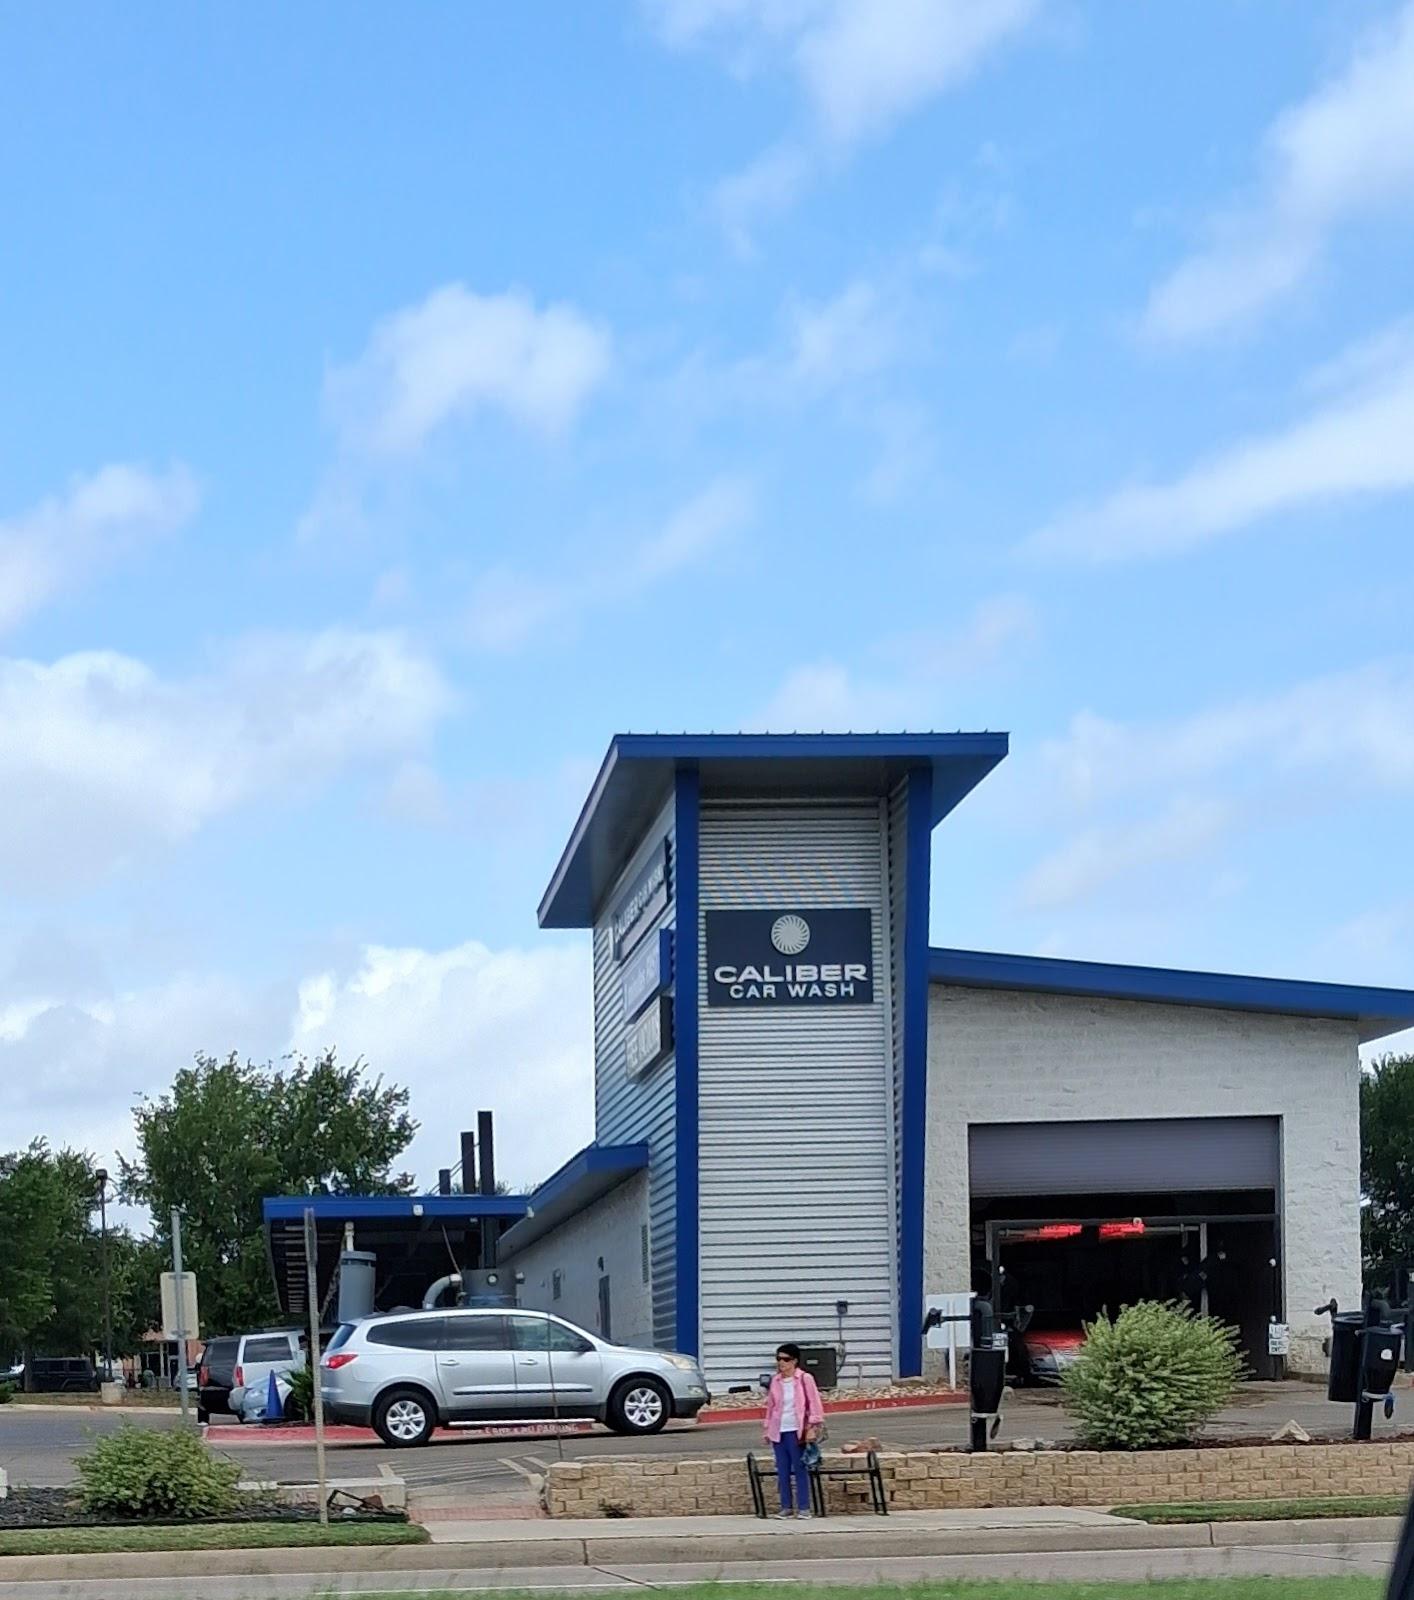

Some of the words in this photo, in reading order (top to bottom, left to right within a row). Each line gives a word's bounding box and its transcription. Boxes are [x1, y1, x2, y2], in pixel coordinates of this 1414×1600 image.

[714, 964, 868, 983] CALIBER
[729, 984, 777, 999] CAR
[788, 983, 855, 998] WASH
